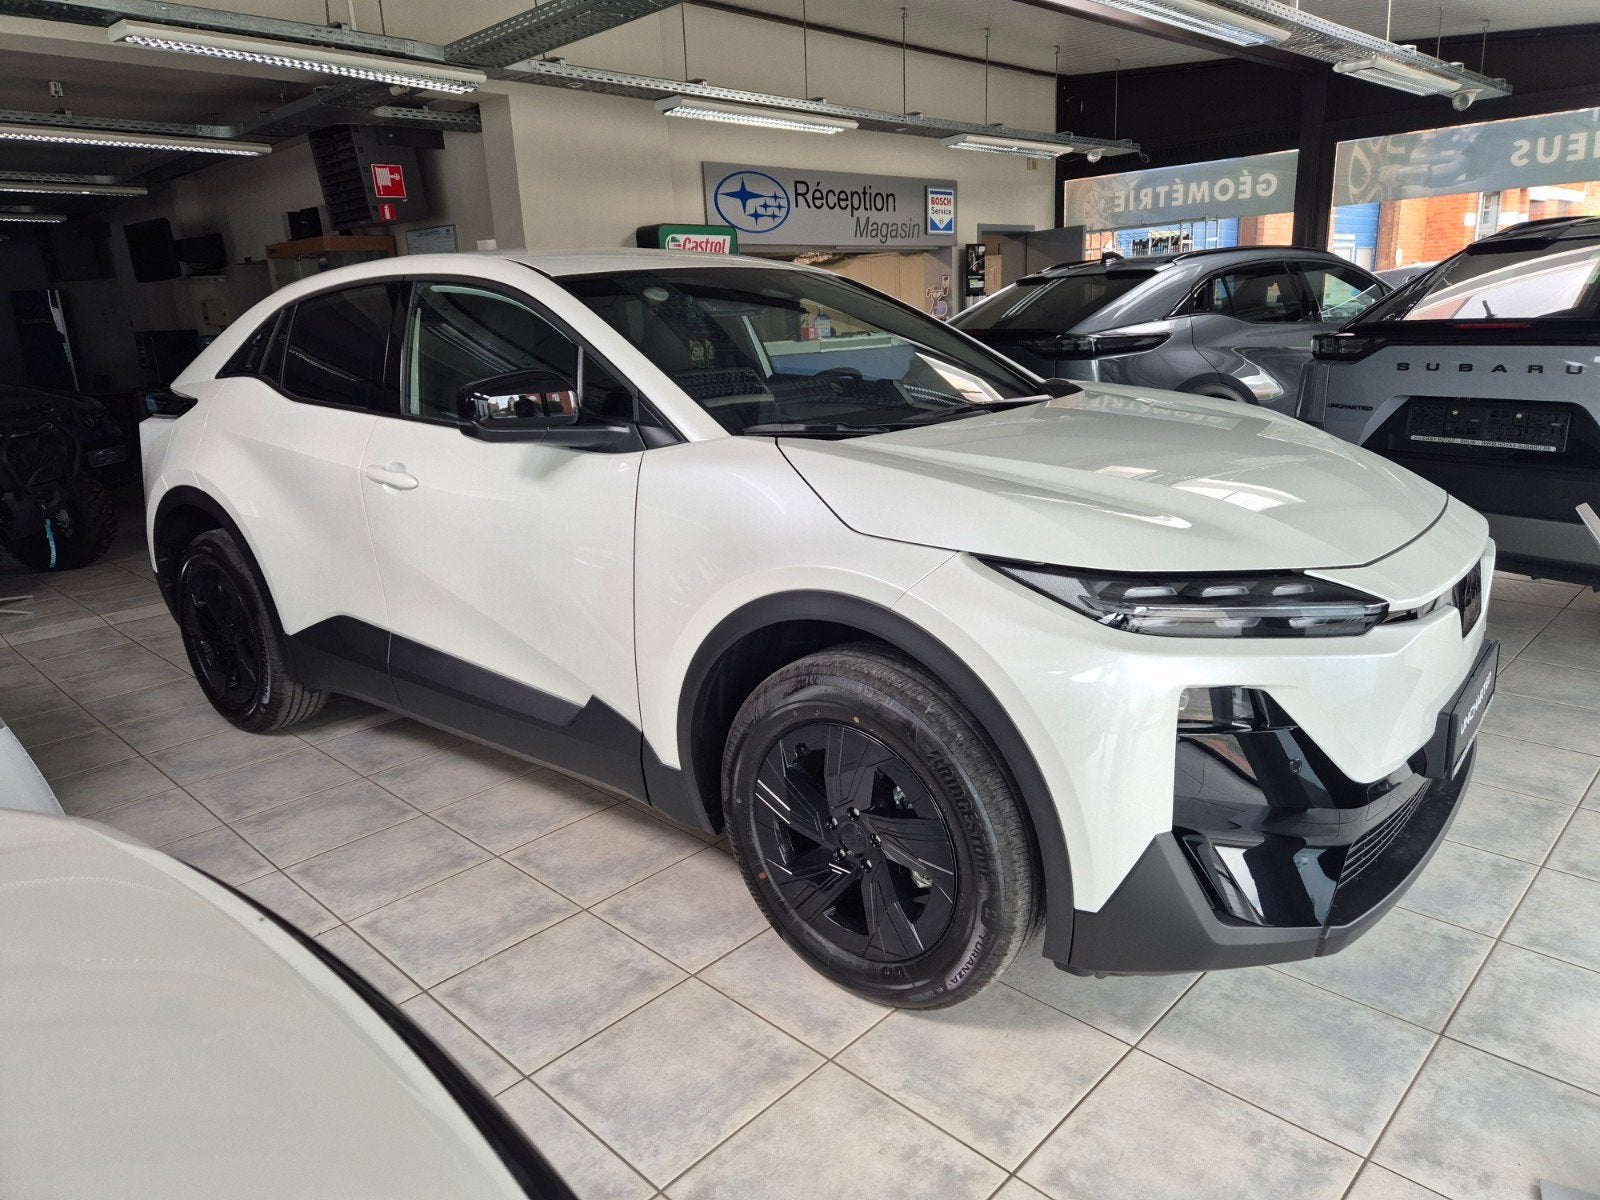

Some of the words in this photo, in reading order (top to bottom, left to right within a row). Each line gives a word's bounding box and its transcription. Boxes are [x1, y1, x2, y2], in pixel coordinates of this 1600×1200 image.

[794, 180, 896, 217] Réception
[930, 196, 952, 206] BOSCH
[931, 206, 952, 216] Service
[854, 216, 920, 244] Magasin
[682, 237, 726, 254] Castrol
[1396, 362, 1583, 375] SUBARU
[1327, 403, 1374, 411] UNCHARTED
[1461, 671, 1492, 735] UNCHARTED
[949, 934, 986, 985] TURANZA
